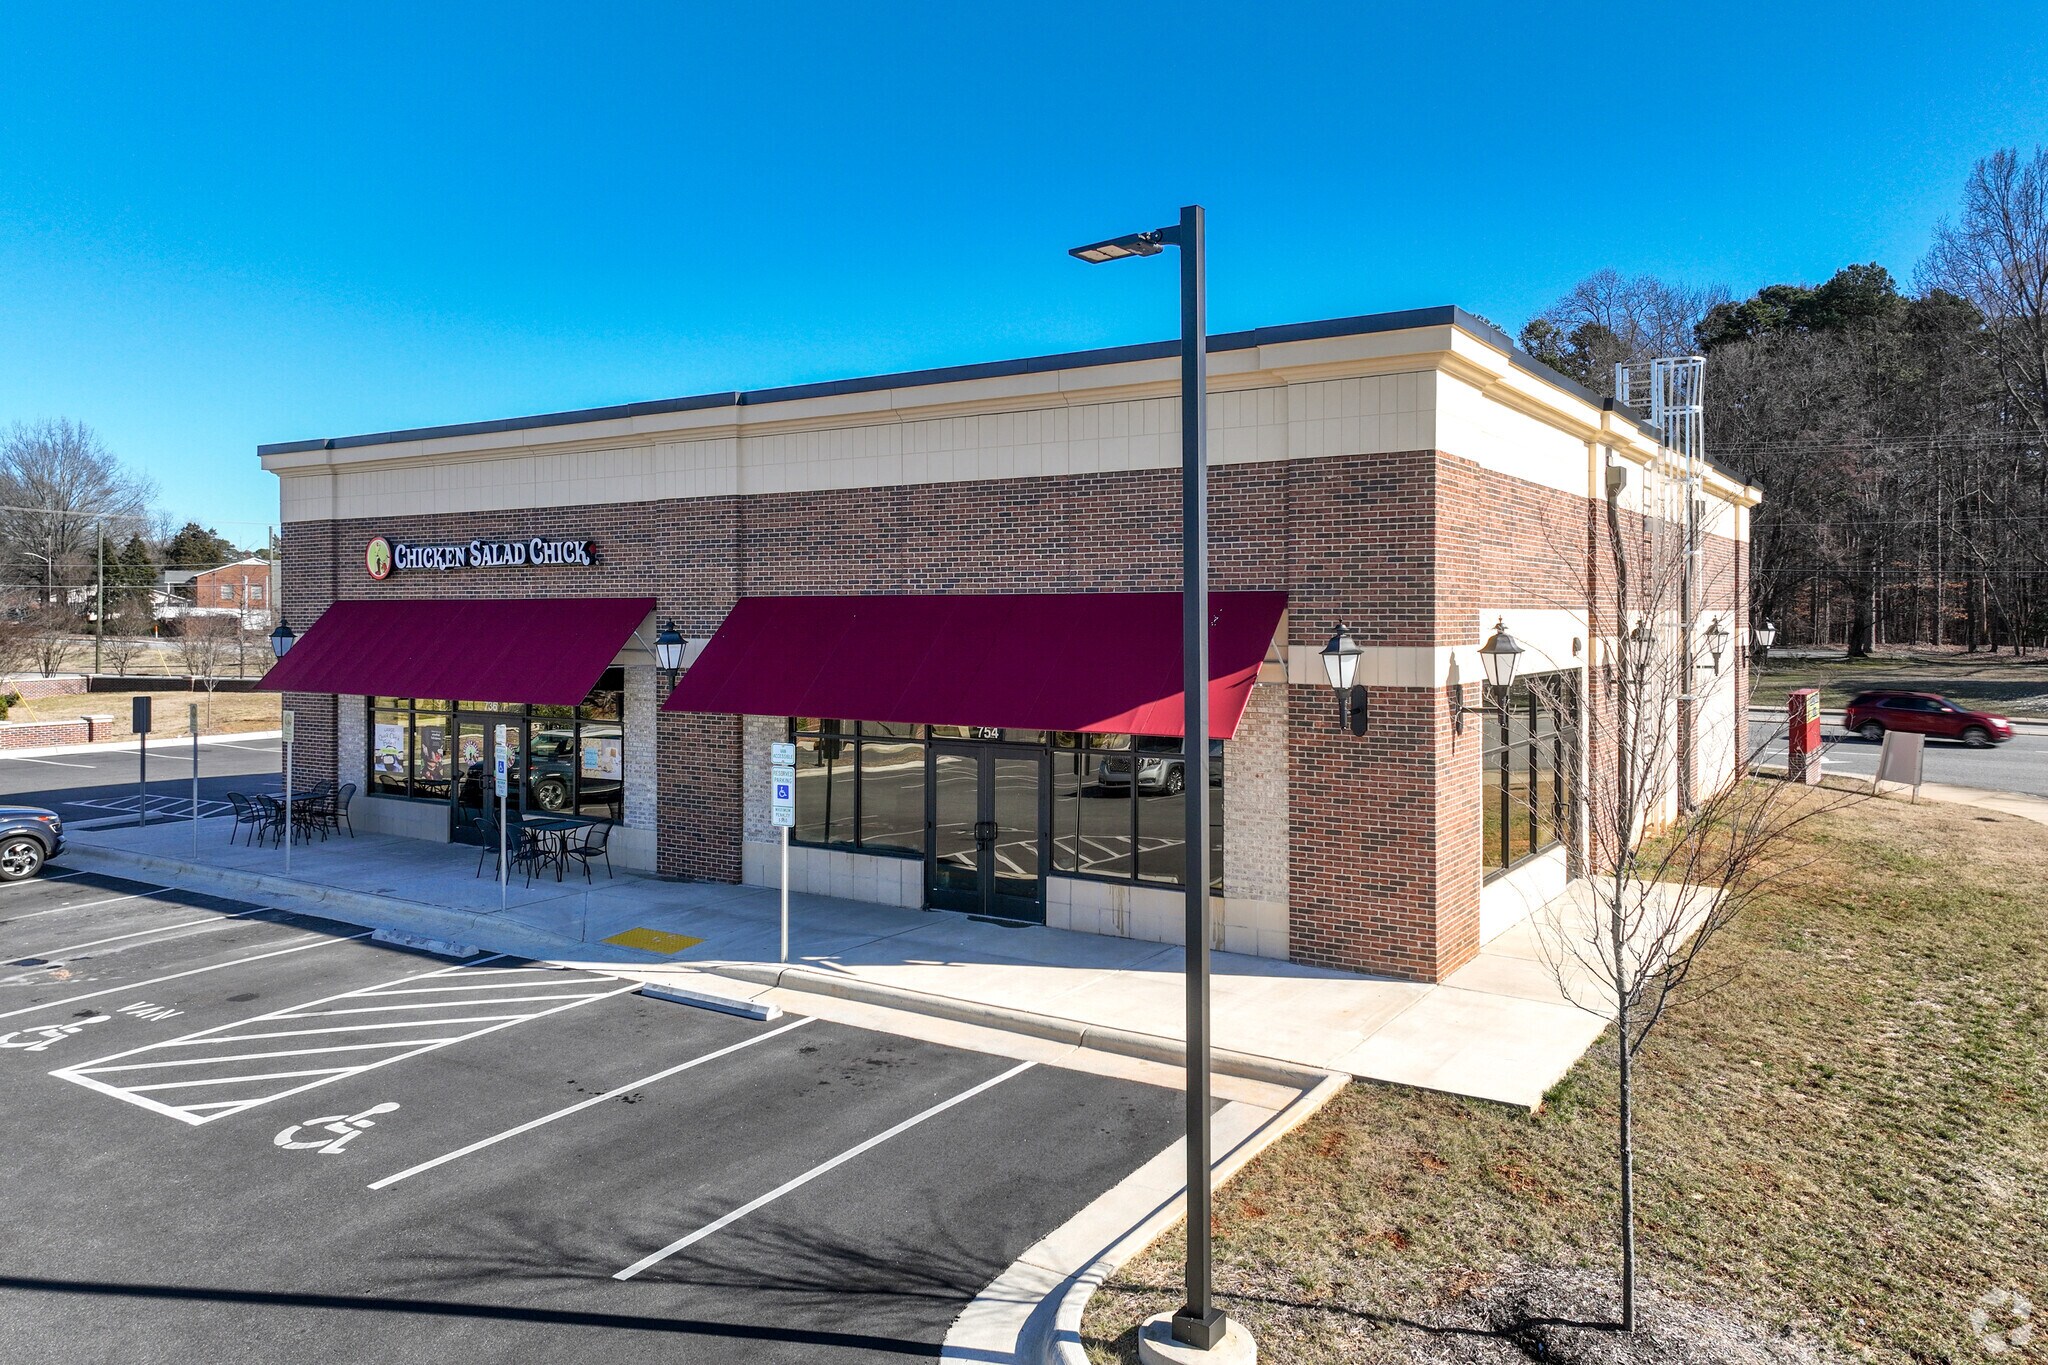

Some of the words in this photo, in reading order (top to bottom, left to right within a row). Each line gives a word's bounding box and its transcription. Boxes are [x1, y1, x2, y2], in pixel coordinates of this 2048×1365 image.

[395, 545, 467, 570] CHICKEN
[469, 540, 526, 566] SALAD
[529, 537, 590, 566] CHICK
[977, 726, 999, 739] 754
[116, 1001, 185, 1021] VAN
